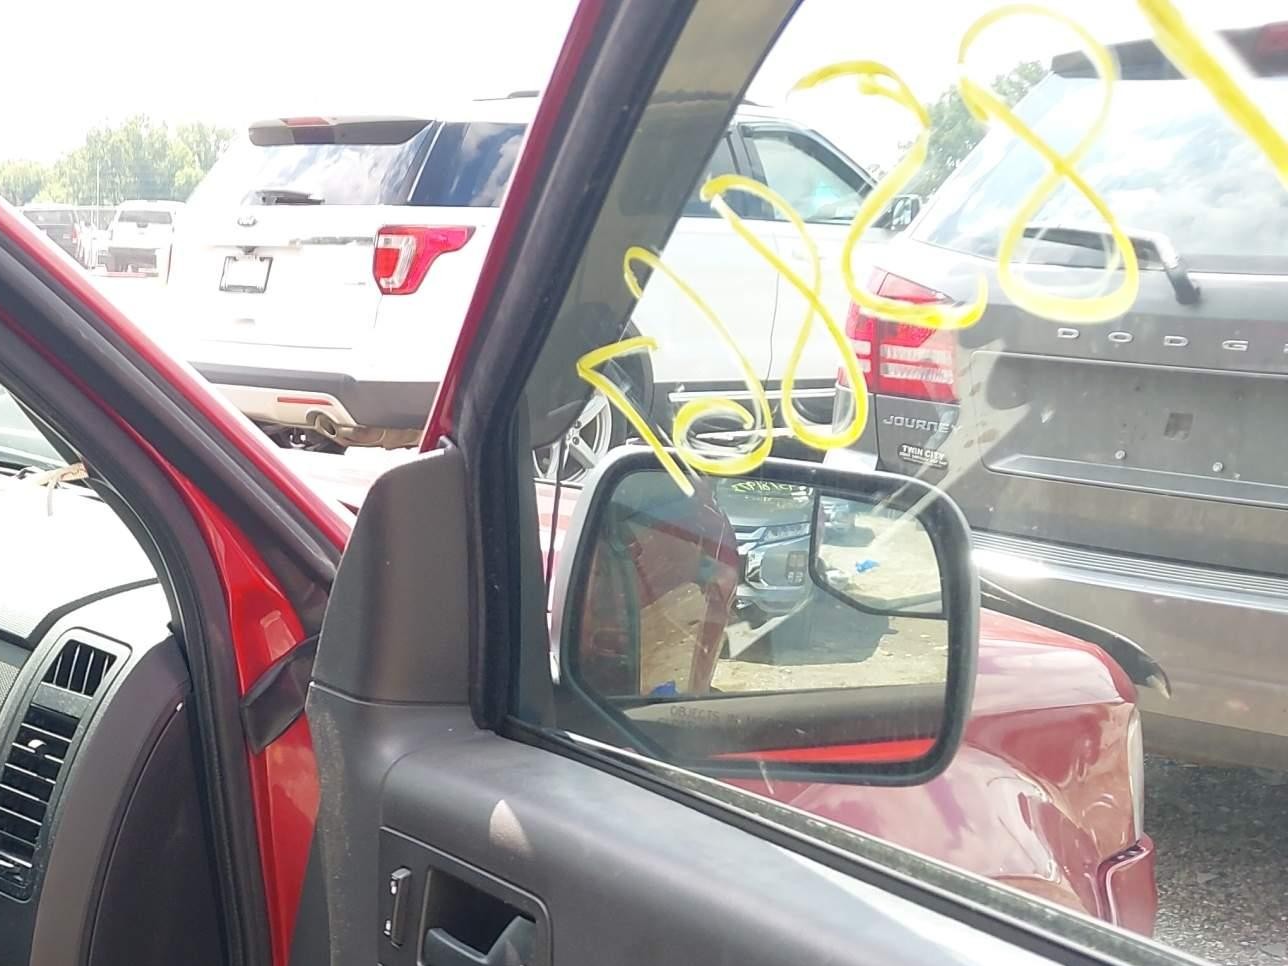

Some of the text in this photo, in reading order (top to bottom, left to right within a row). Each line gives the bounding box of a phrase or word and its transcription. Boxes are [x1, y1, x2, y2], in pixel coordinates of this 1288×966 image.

[1057, 327, 1288, 353] DODG
[901, 444, 924, 457] TWIN
[924, 450, 945, 460] CITY
